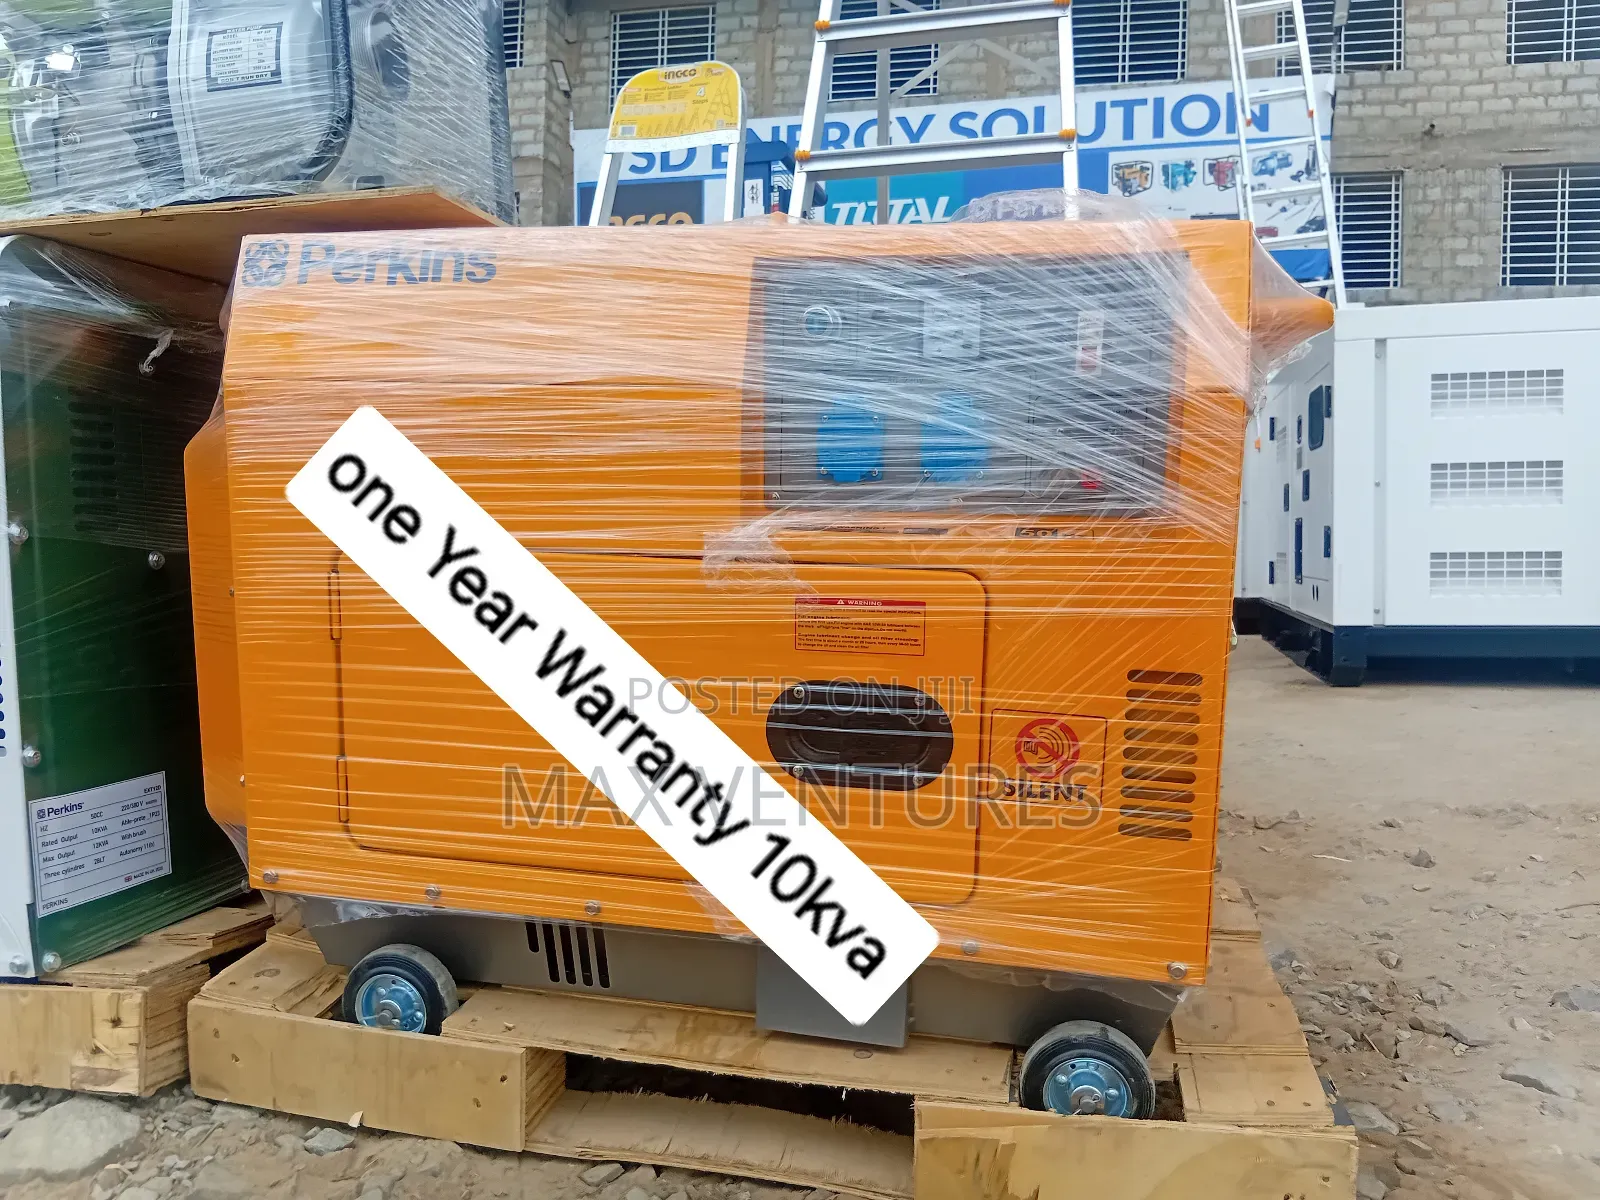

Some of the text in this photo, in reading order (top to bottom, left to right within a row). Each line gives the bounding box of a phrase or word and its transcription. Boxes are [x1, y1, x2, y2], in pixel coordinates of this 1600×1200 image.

[695, 86, 706, 97] 4
[628, 147, 697, 174] SD
[297, 240, 497, 286] Perkins
[1003, 778, 1088, 802] SILENT
[47, 802, 83, 818] Perkins
[41, 838, 58, 848] Rated
[61, 834, 78, 843] Output
[57, 850, 75, 860] Output
[44, 870, 61, 879] Three
[42, 898, 69, 910] PERKINS
